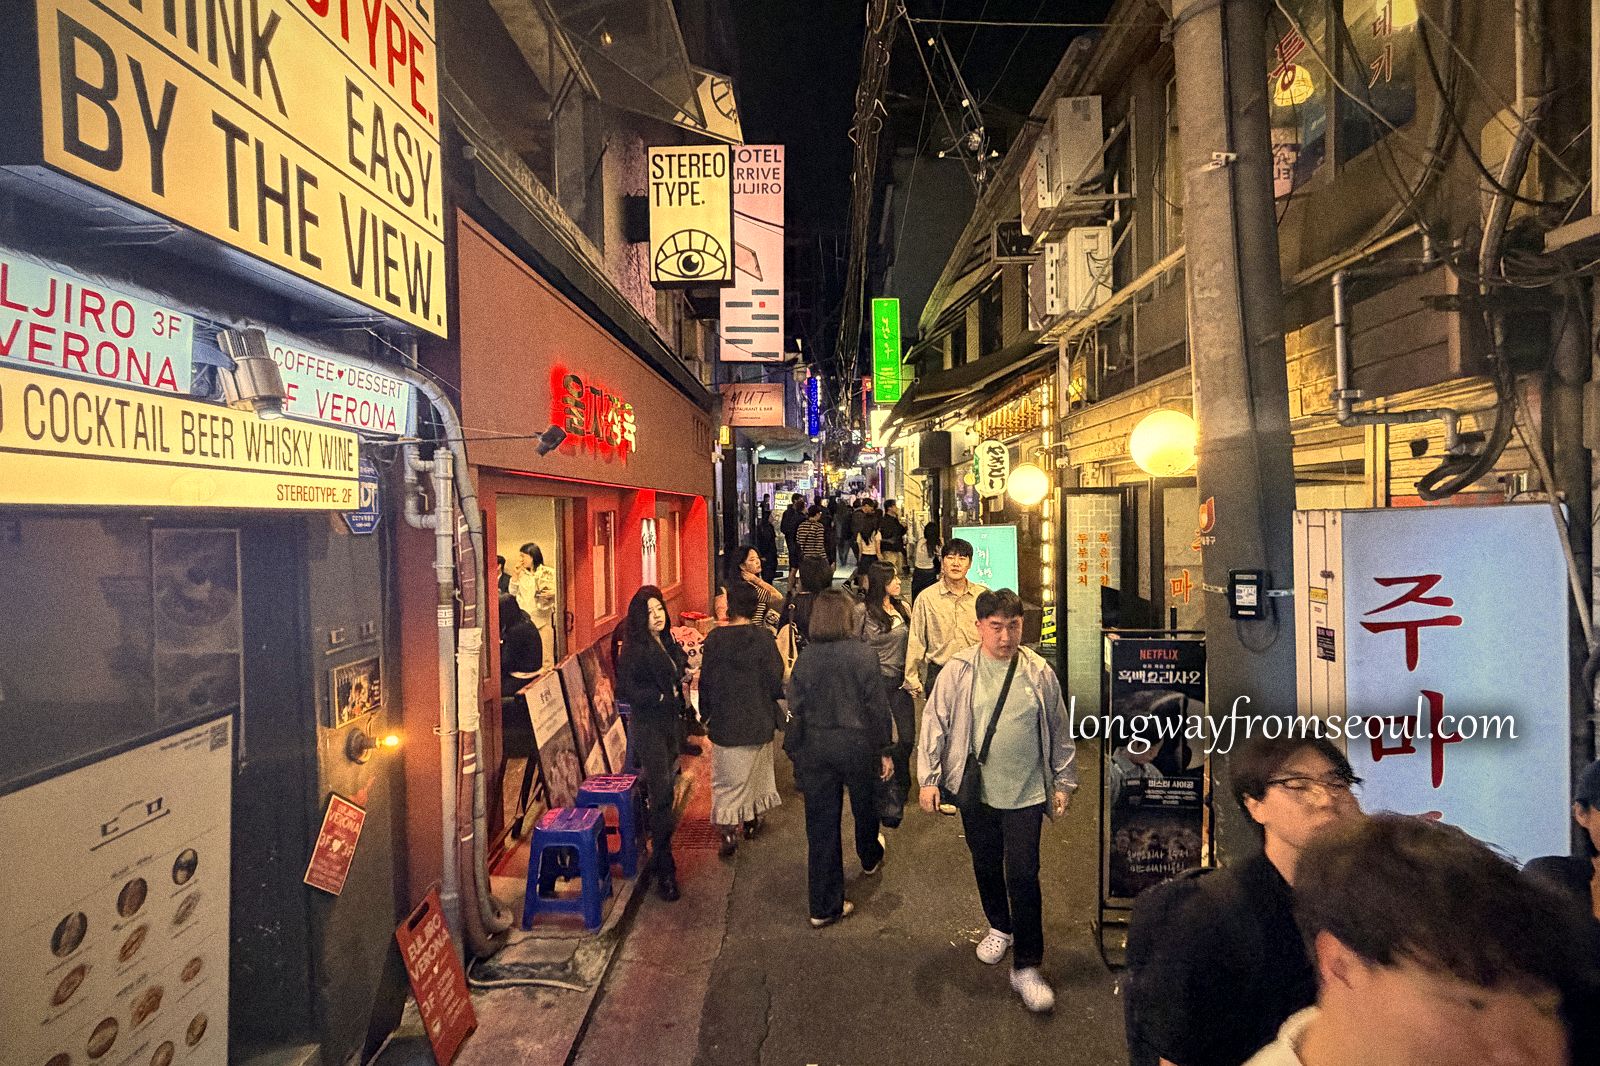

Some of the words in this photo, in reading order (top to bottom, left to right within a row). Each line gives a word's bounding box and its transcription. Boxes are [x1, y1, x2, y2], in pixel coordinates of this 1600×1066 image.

[345, 75, 438, 227] EASY.
[733, 149, 782, 163] OTEL
[56, 9, 178, 198] BY
[211, 109, 323, 271] THE
[339, 192, 442, 327] VIEW.
[652, 152, 726, 179] STEREO
[733, 168, 780, 180] RRIVE
[652, 181, 706, 207] TYPE.
[152, 311, 182, 339] 3F
[0, 318, 179, 392] VERONA
[273, 346, 335, 382] COFFEE
[347, 368, 403, 399] DESSERT
[315, 388, 397, 431] VERONA
[730, 390, 772, 405] MUT
[23, 383, 170, 453] COCKTAIL
[181, 410, 235, 459] BEER
[243, 420, 313, 468] WHISKY
[319, 433, 354, 472] WINE
[987, 445, 1005, 489] やきとり
[277, 484, 339, 503] STEREOTYPE.
[342, 488, 353, 503] 2F
[360, 482, 378, 513] DT
[1139, 650, 1179, 660] NETFLIX
[1118, 670, 1201, 684] 흑백요리사2
[328, 811, 360, 834] VERONA
